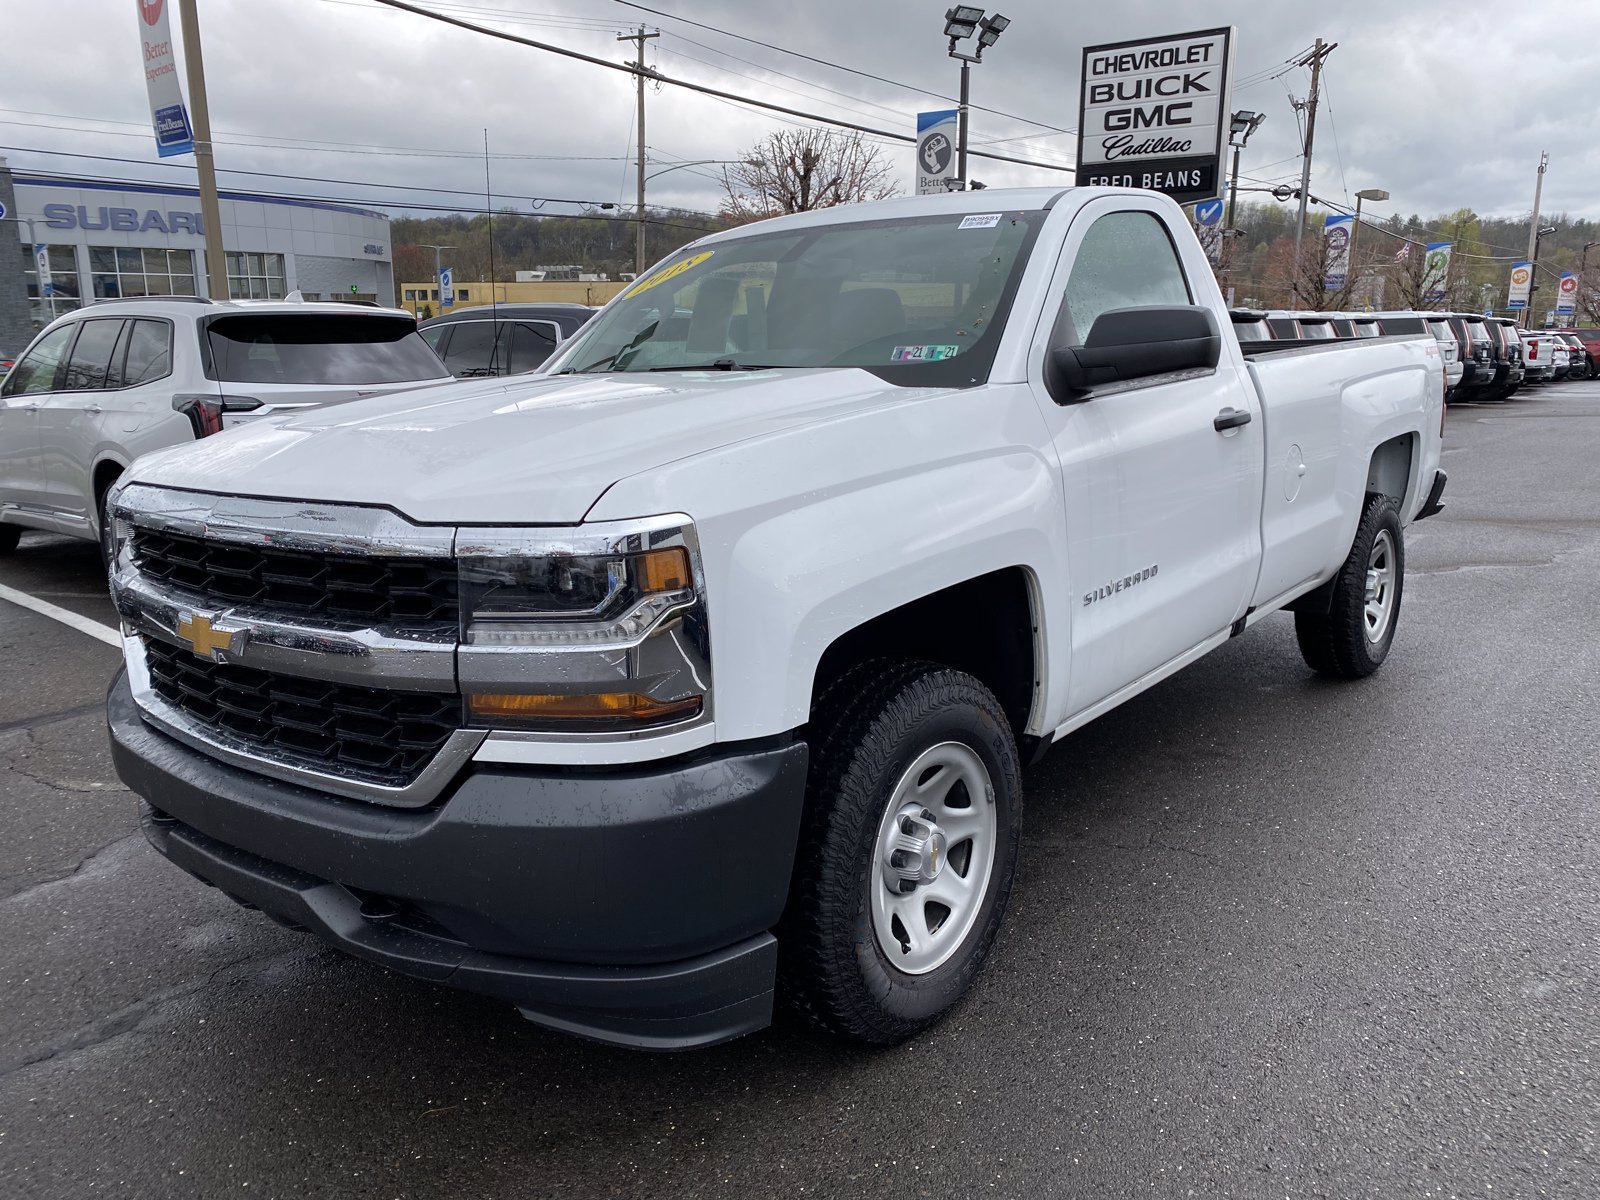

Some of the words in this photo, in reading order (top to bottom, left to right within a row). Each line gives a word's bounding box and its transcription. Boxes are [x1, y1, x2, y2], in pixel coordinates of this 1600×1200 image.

[144, 41, 169, 61] Better
[1092, 43, 1214, 75] CHEVROLET
[146, 62, 176, 82] Experience
[1090, 71, 1211, 104] BUICK
[1104, 102, 1193, 131] GMC
[1102, 135, 1192, 161] Cadillac
[920, 177, 945, 188] Bette
[1089, 175, 1133, 187] FRED
[1142, 170, 1201, 188] BEANS
[913, 346, 923, 358] 21
[945, 346, 956, 358] 21
[1083, 564, 1158, 607] SILVERADO
